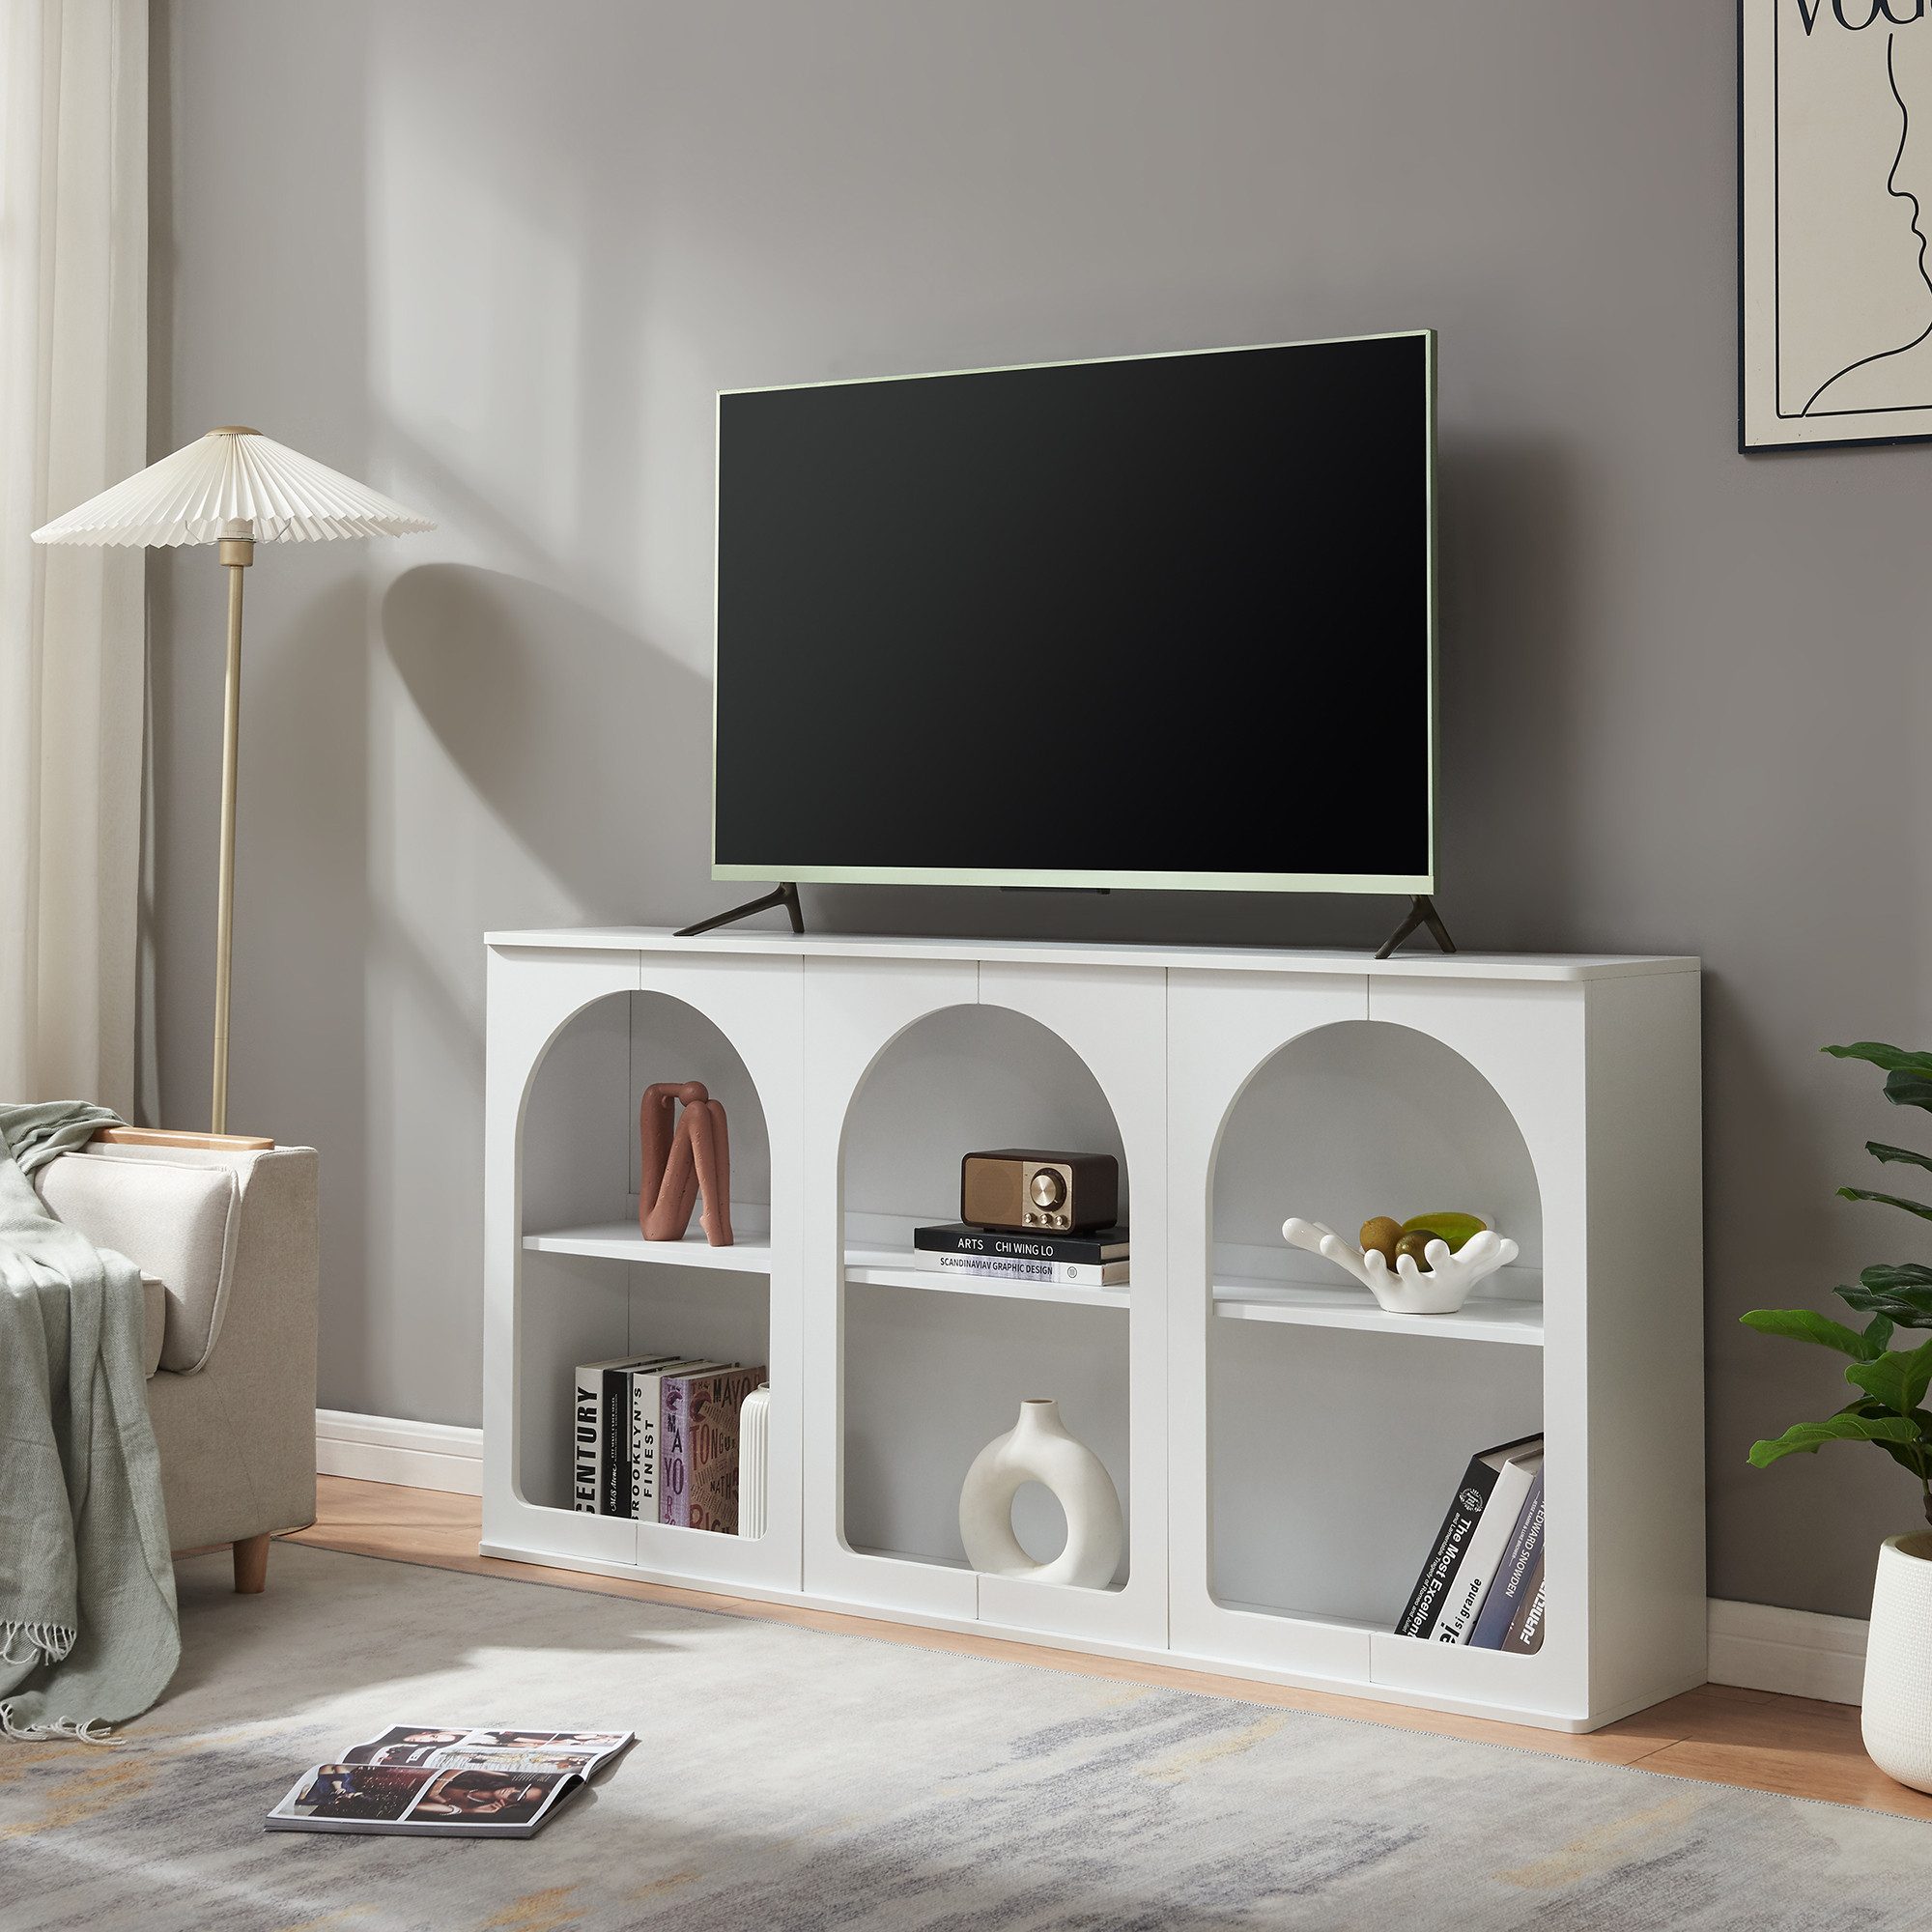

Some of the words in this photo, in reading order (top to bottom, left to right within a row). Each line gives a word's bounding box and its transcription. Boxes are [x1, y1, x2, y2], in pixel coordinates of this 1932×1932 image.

[957, 1237, 984, 1250] ARTS
[995, 1241, 1011, 1253] CHI
[1012, 1243, 1039, 1256] WING
[1040, 1245, 1054, 1256] LO
[992, 1262, 1025, 1273] GRAPHIC
[1026, 1264, 1053, 1275] DESIGN
[643, 1419, 654, 1497] FINEST
[1452, 1512, 1461, 1524] and
[1452, 1518, 1472, 1543] The
[1426, 1556, 1441, 1580] Tragedy
[1435, 1544, 1460, 1578] Most
[1505, 1549, 1530, 1598] SNOWDEN
[1460, 1577, 1483, 1619] grande
